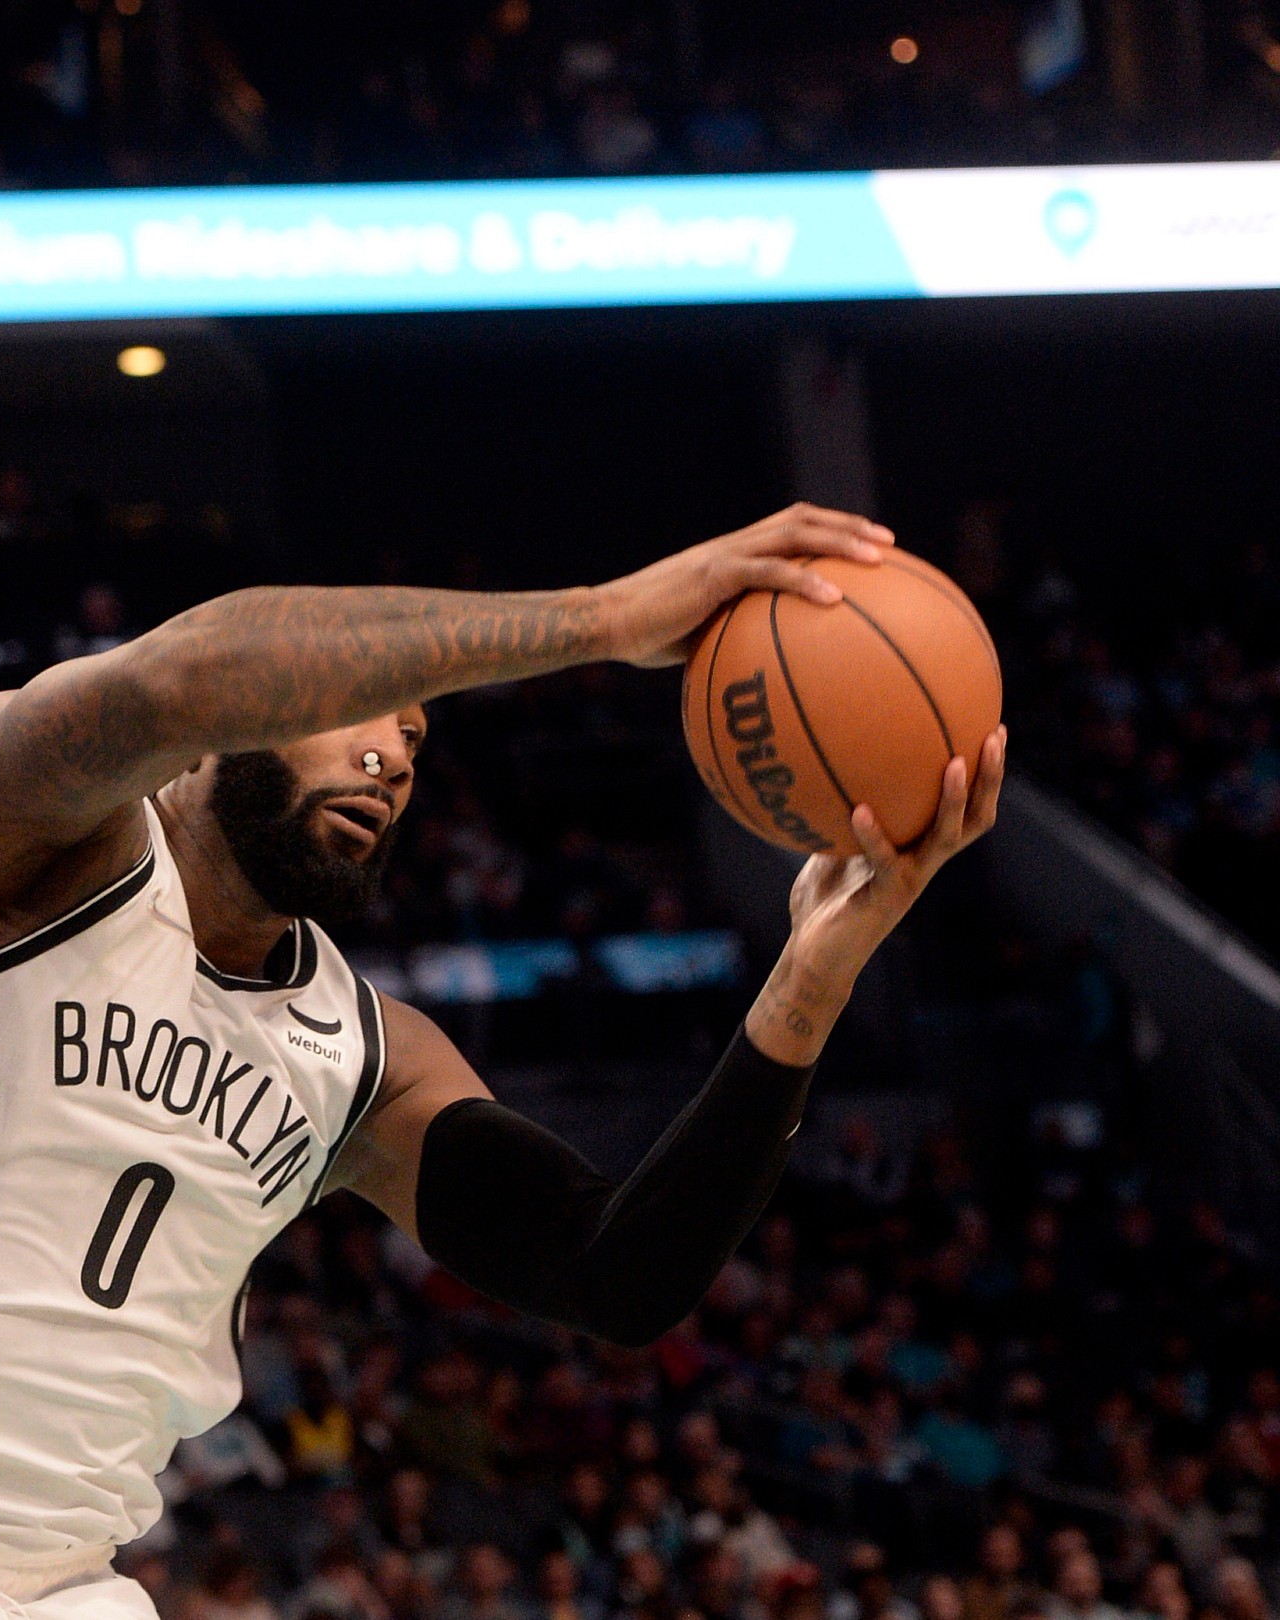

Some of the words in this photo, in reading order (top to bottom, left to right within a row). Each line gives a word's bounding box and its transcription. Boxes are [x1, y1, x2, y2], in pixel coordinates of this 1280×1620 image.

[133, 214, 459, 278] Rideshare
[471, 211, 520, 273] &
[530, 204, 796, 277] Delivery
[287, 1031, 342, 1065] Webull
[55, 1001, 310, 1208] BROOKLYN
[81, 1161, 175, 1309] 0
